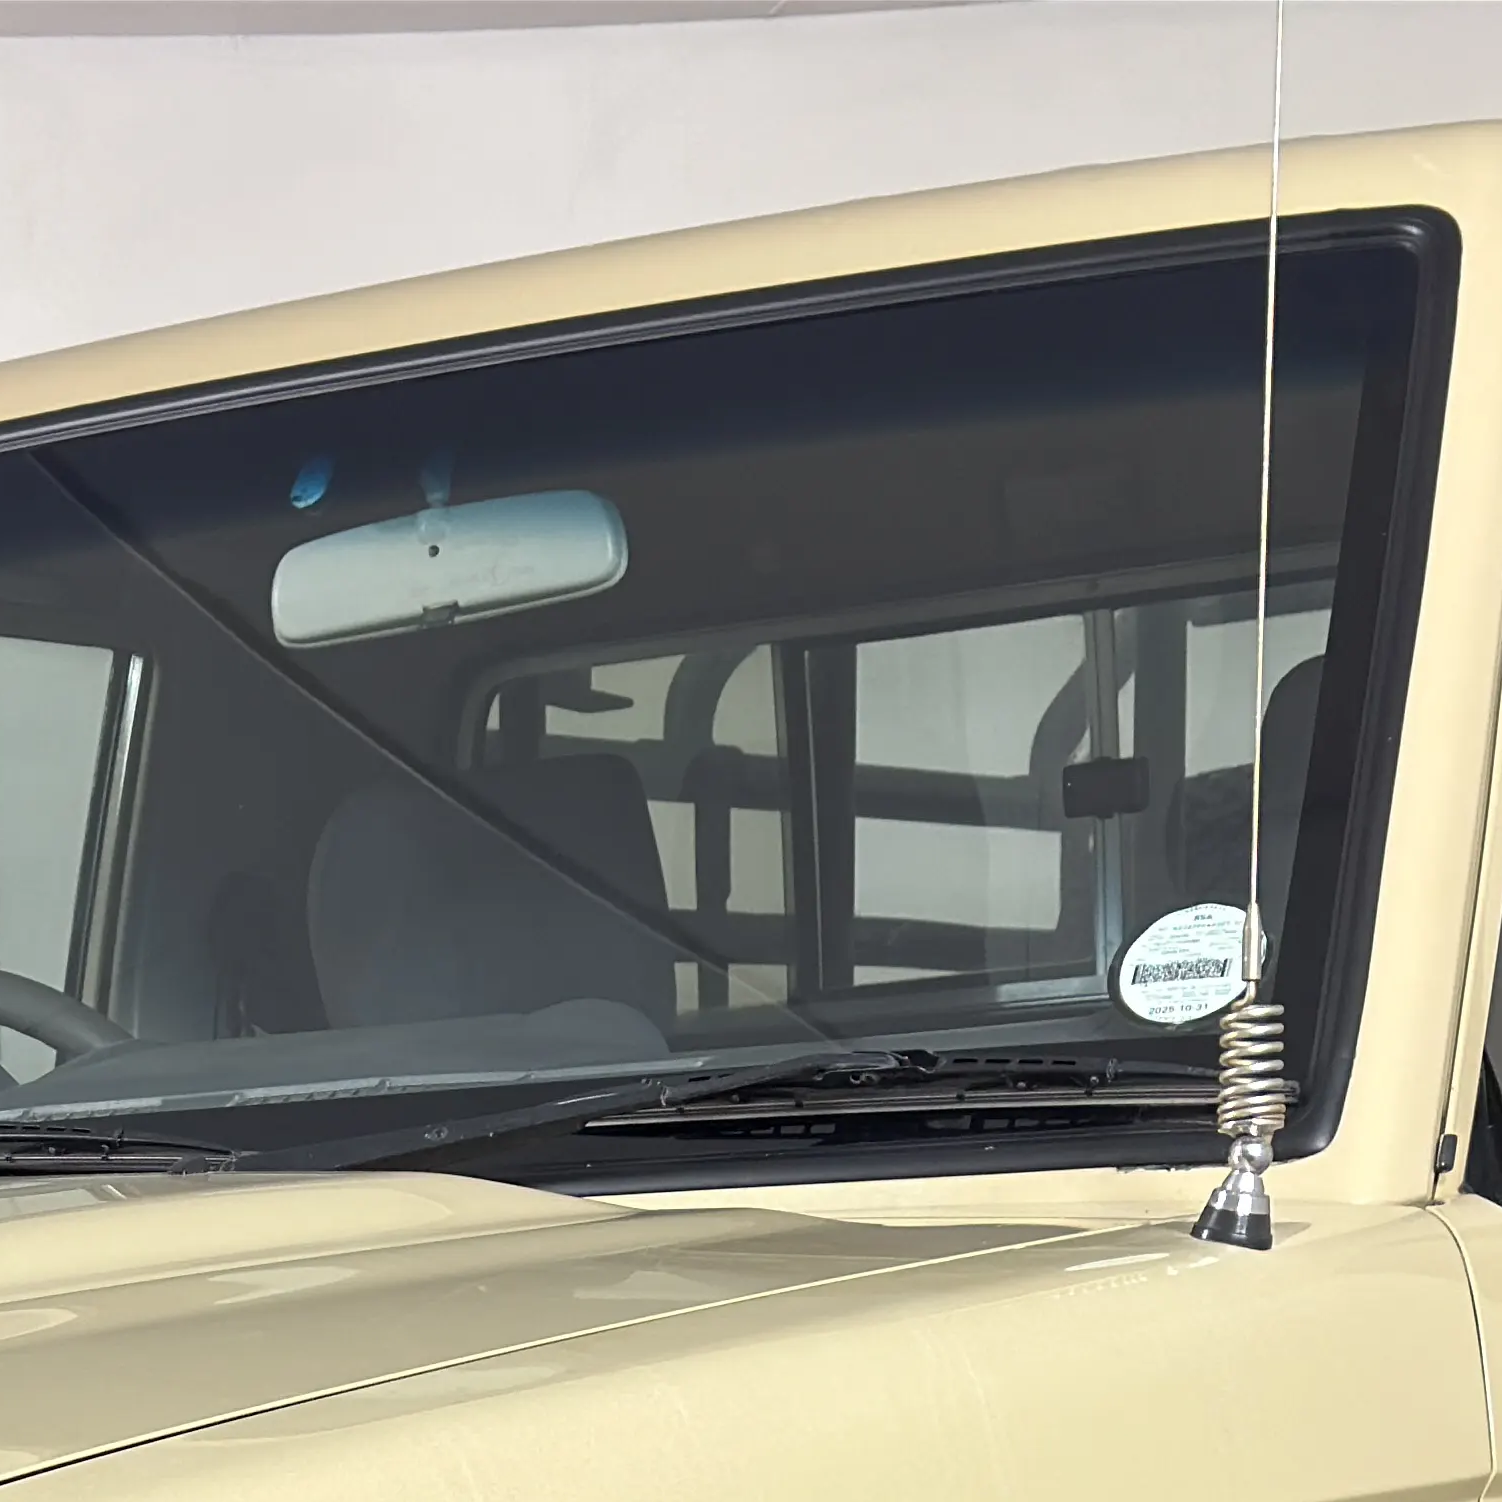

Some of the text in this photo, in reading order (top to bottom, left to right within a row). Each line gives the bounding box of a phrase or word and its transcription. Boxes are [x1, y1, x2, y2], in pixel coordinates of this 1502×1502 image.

[1148, 1003, 1208, 1015] 2025 10 31
